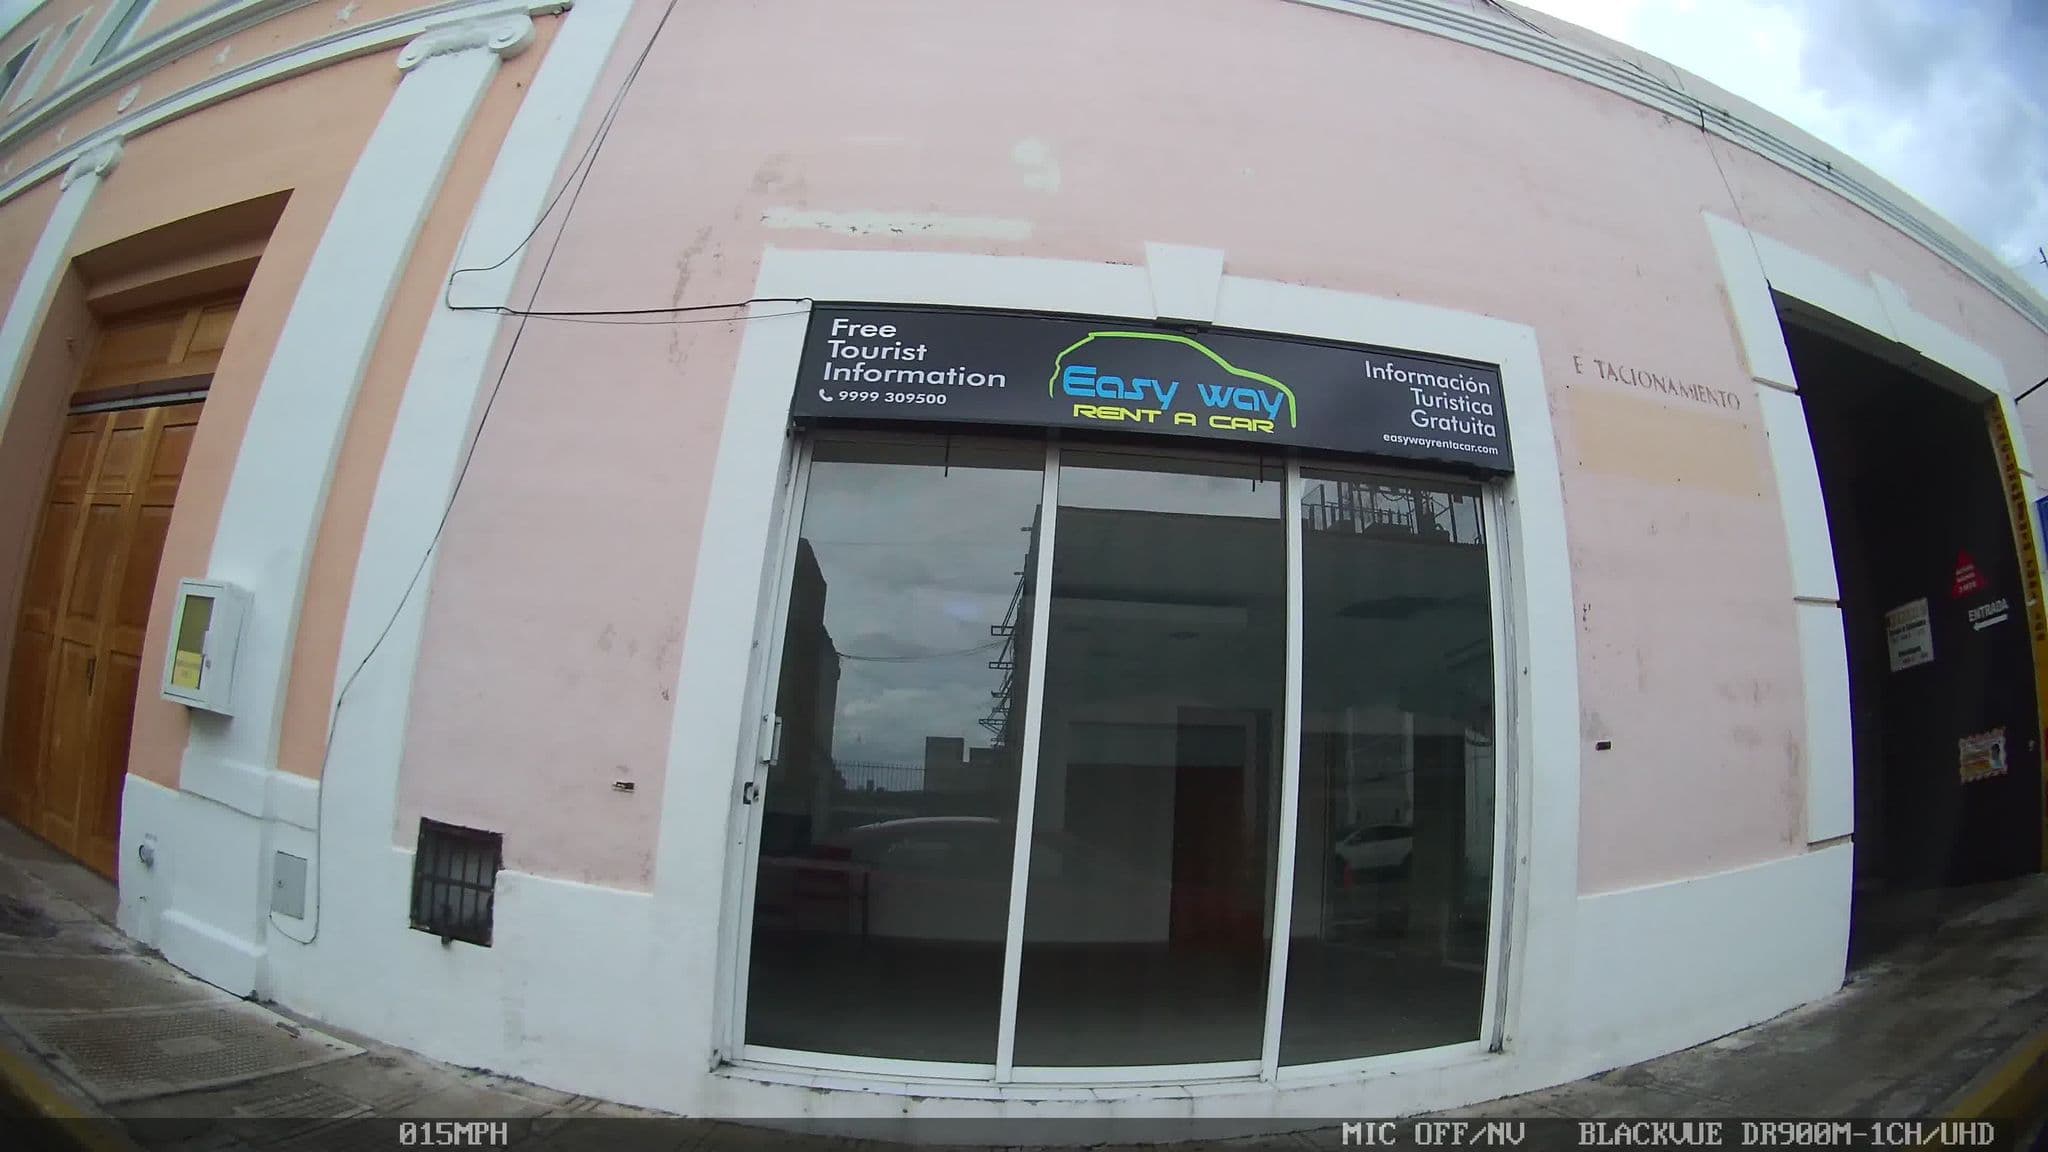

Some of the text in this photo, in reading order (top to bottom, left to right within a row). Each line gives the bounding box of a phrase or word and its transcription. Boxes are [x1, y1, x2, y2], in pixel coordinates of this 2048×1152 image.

[831, 318, 897, 339] Free
[827, 339, 928, 361] Tourist
[823, 361, 1007, 389] Information
[1365, 360, 1491, 396] Información
[838, 389, 947, 406] 9999 309500
[1063, 365, 1286, 420] Easy way
[1410, 387, 1494, 417] Turistica
[1073, 404, 1275, 434] RENT A CAR
[1410, 409, 1497, 438] Gratuita
[1383, 432, 1499, 456] easywayrentacar.com
[1968, 597, 2010, 623] ENTRADA
